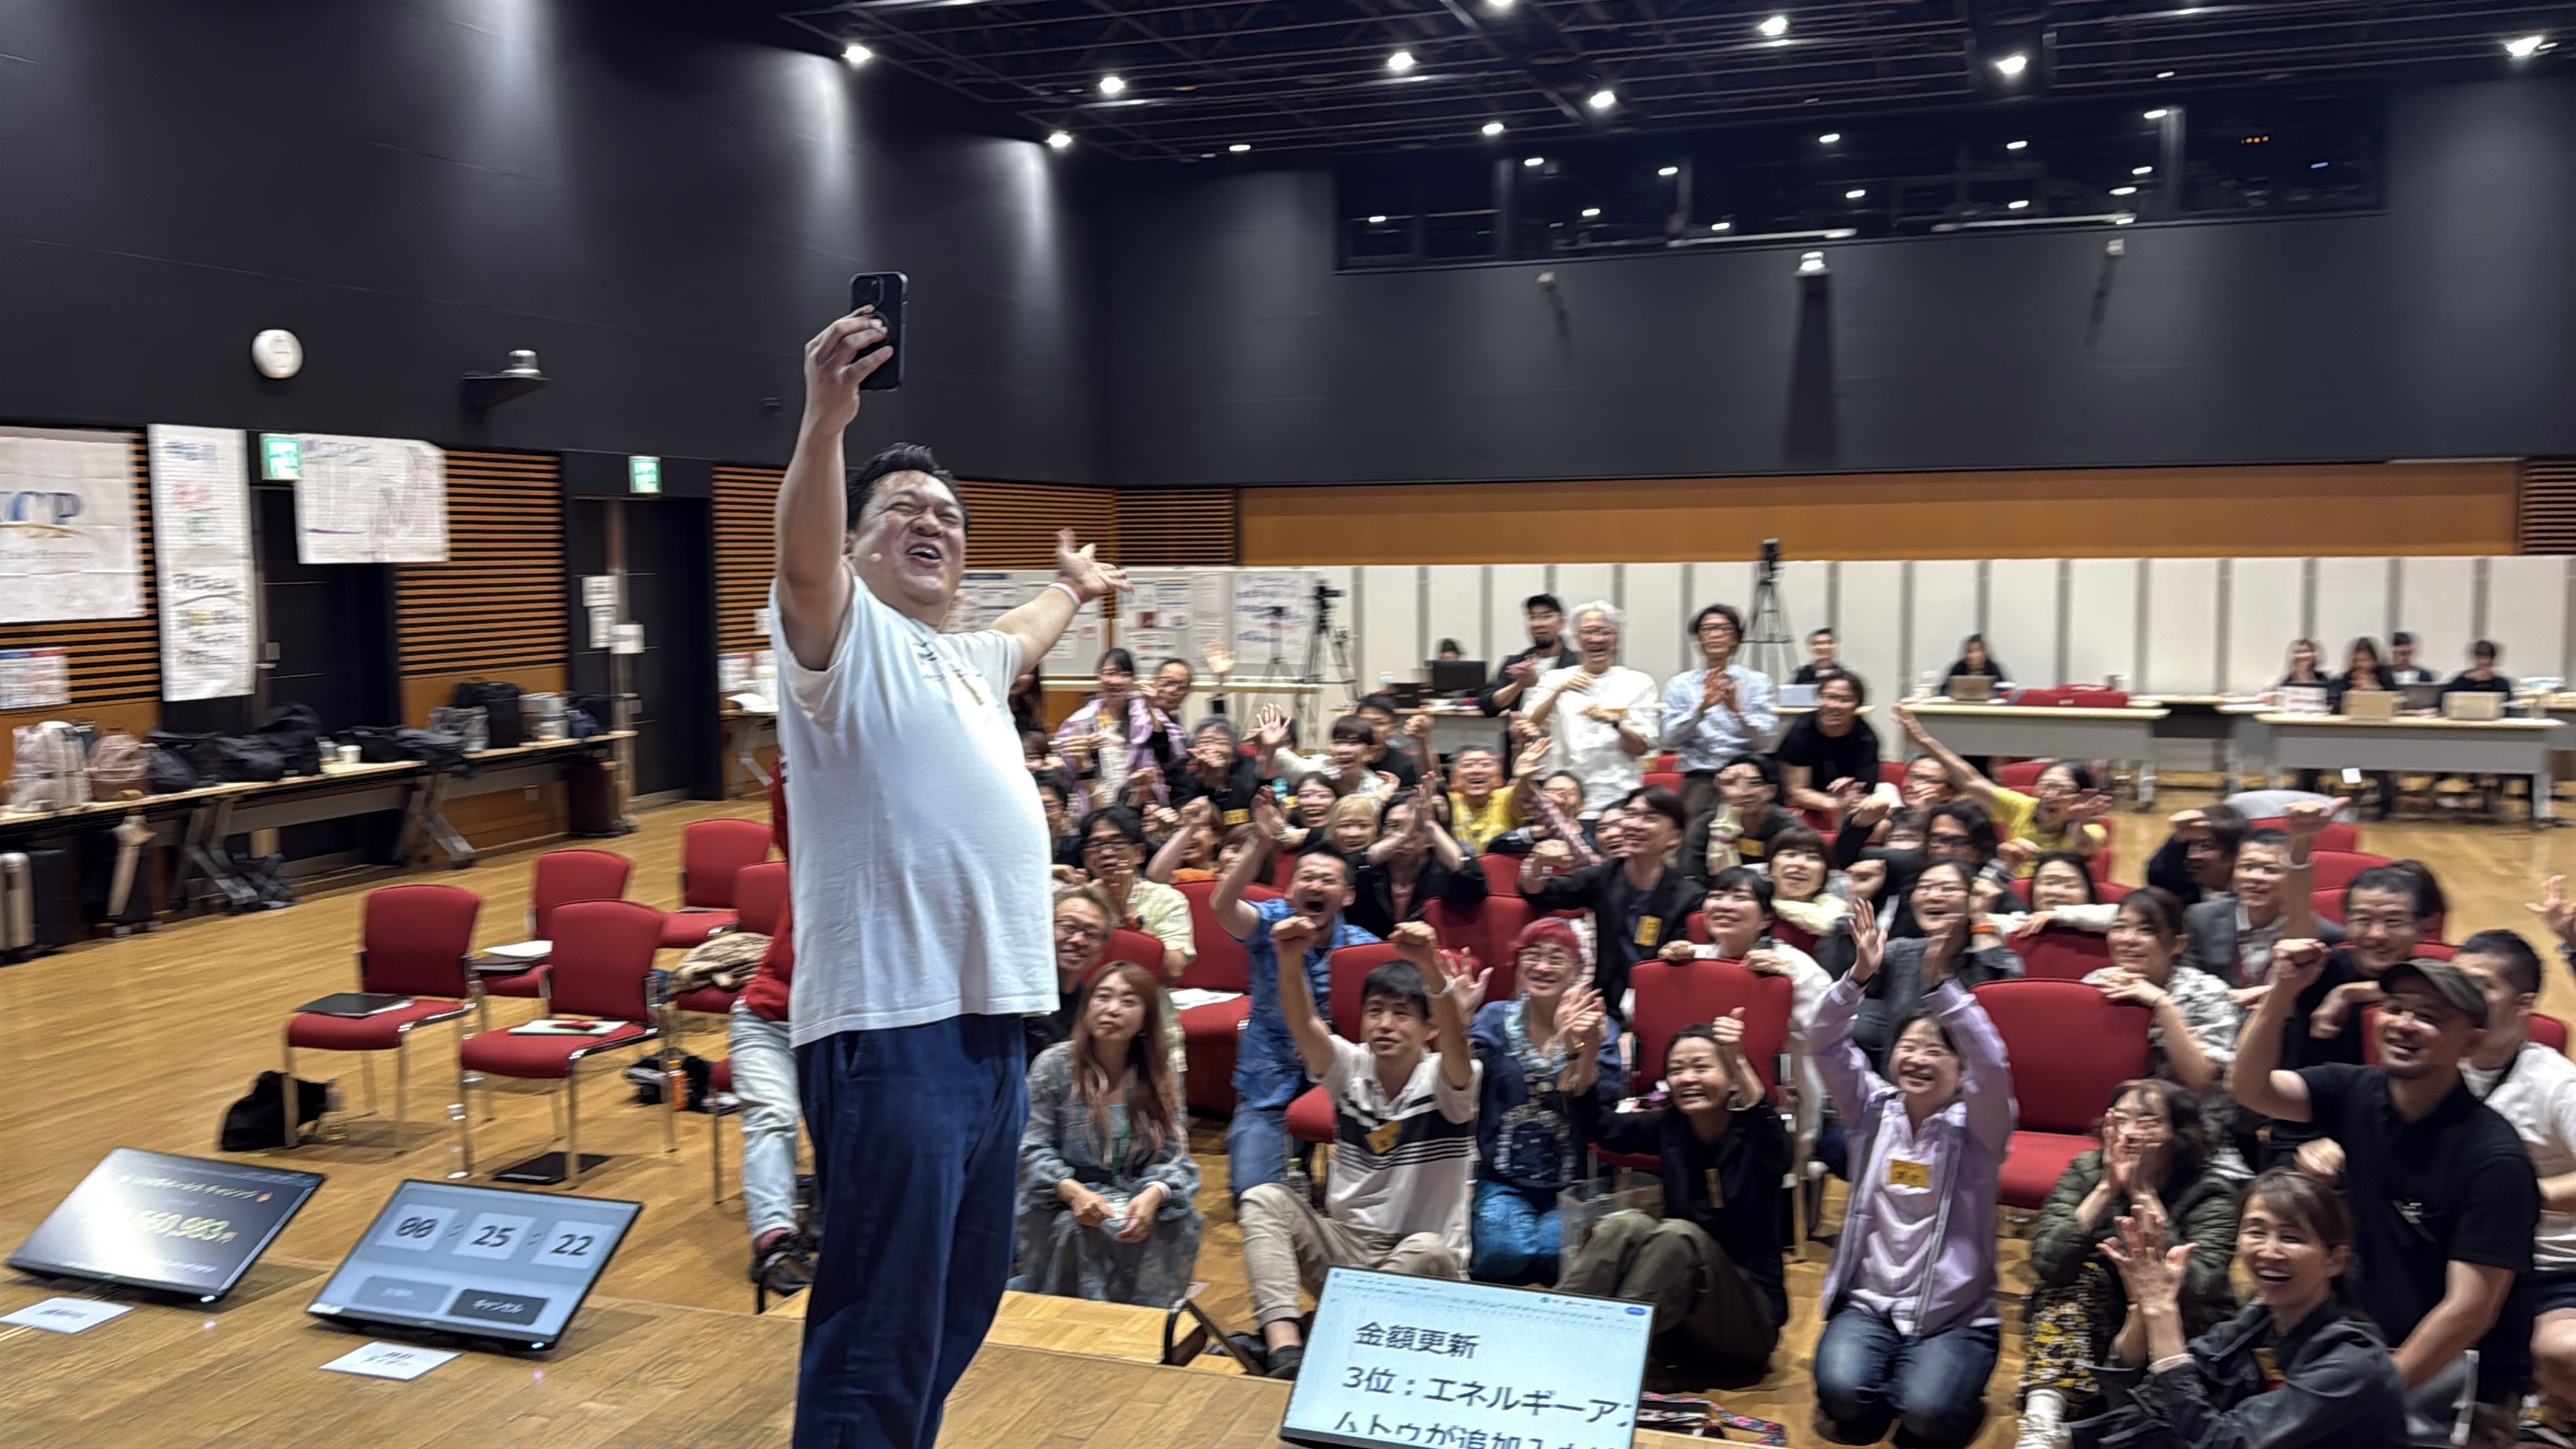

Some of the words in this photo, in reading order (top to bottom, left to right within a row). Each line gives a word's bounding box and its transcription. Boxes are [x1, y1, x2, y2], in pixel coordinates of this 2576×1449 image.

[394, 1216, 439, 1239] 00
[470, 1225, 517, 1248] 25
[550, 1233, 596, 1257] 22
[1353, 1321, 1480, 1359] 金額更新
